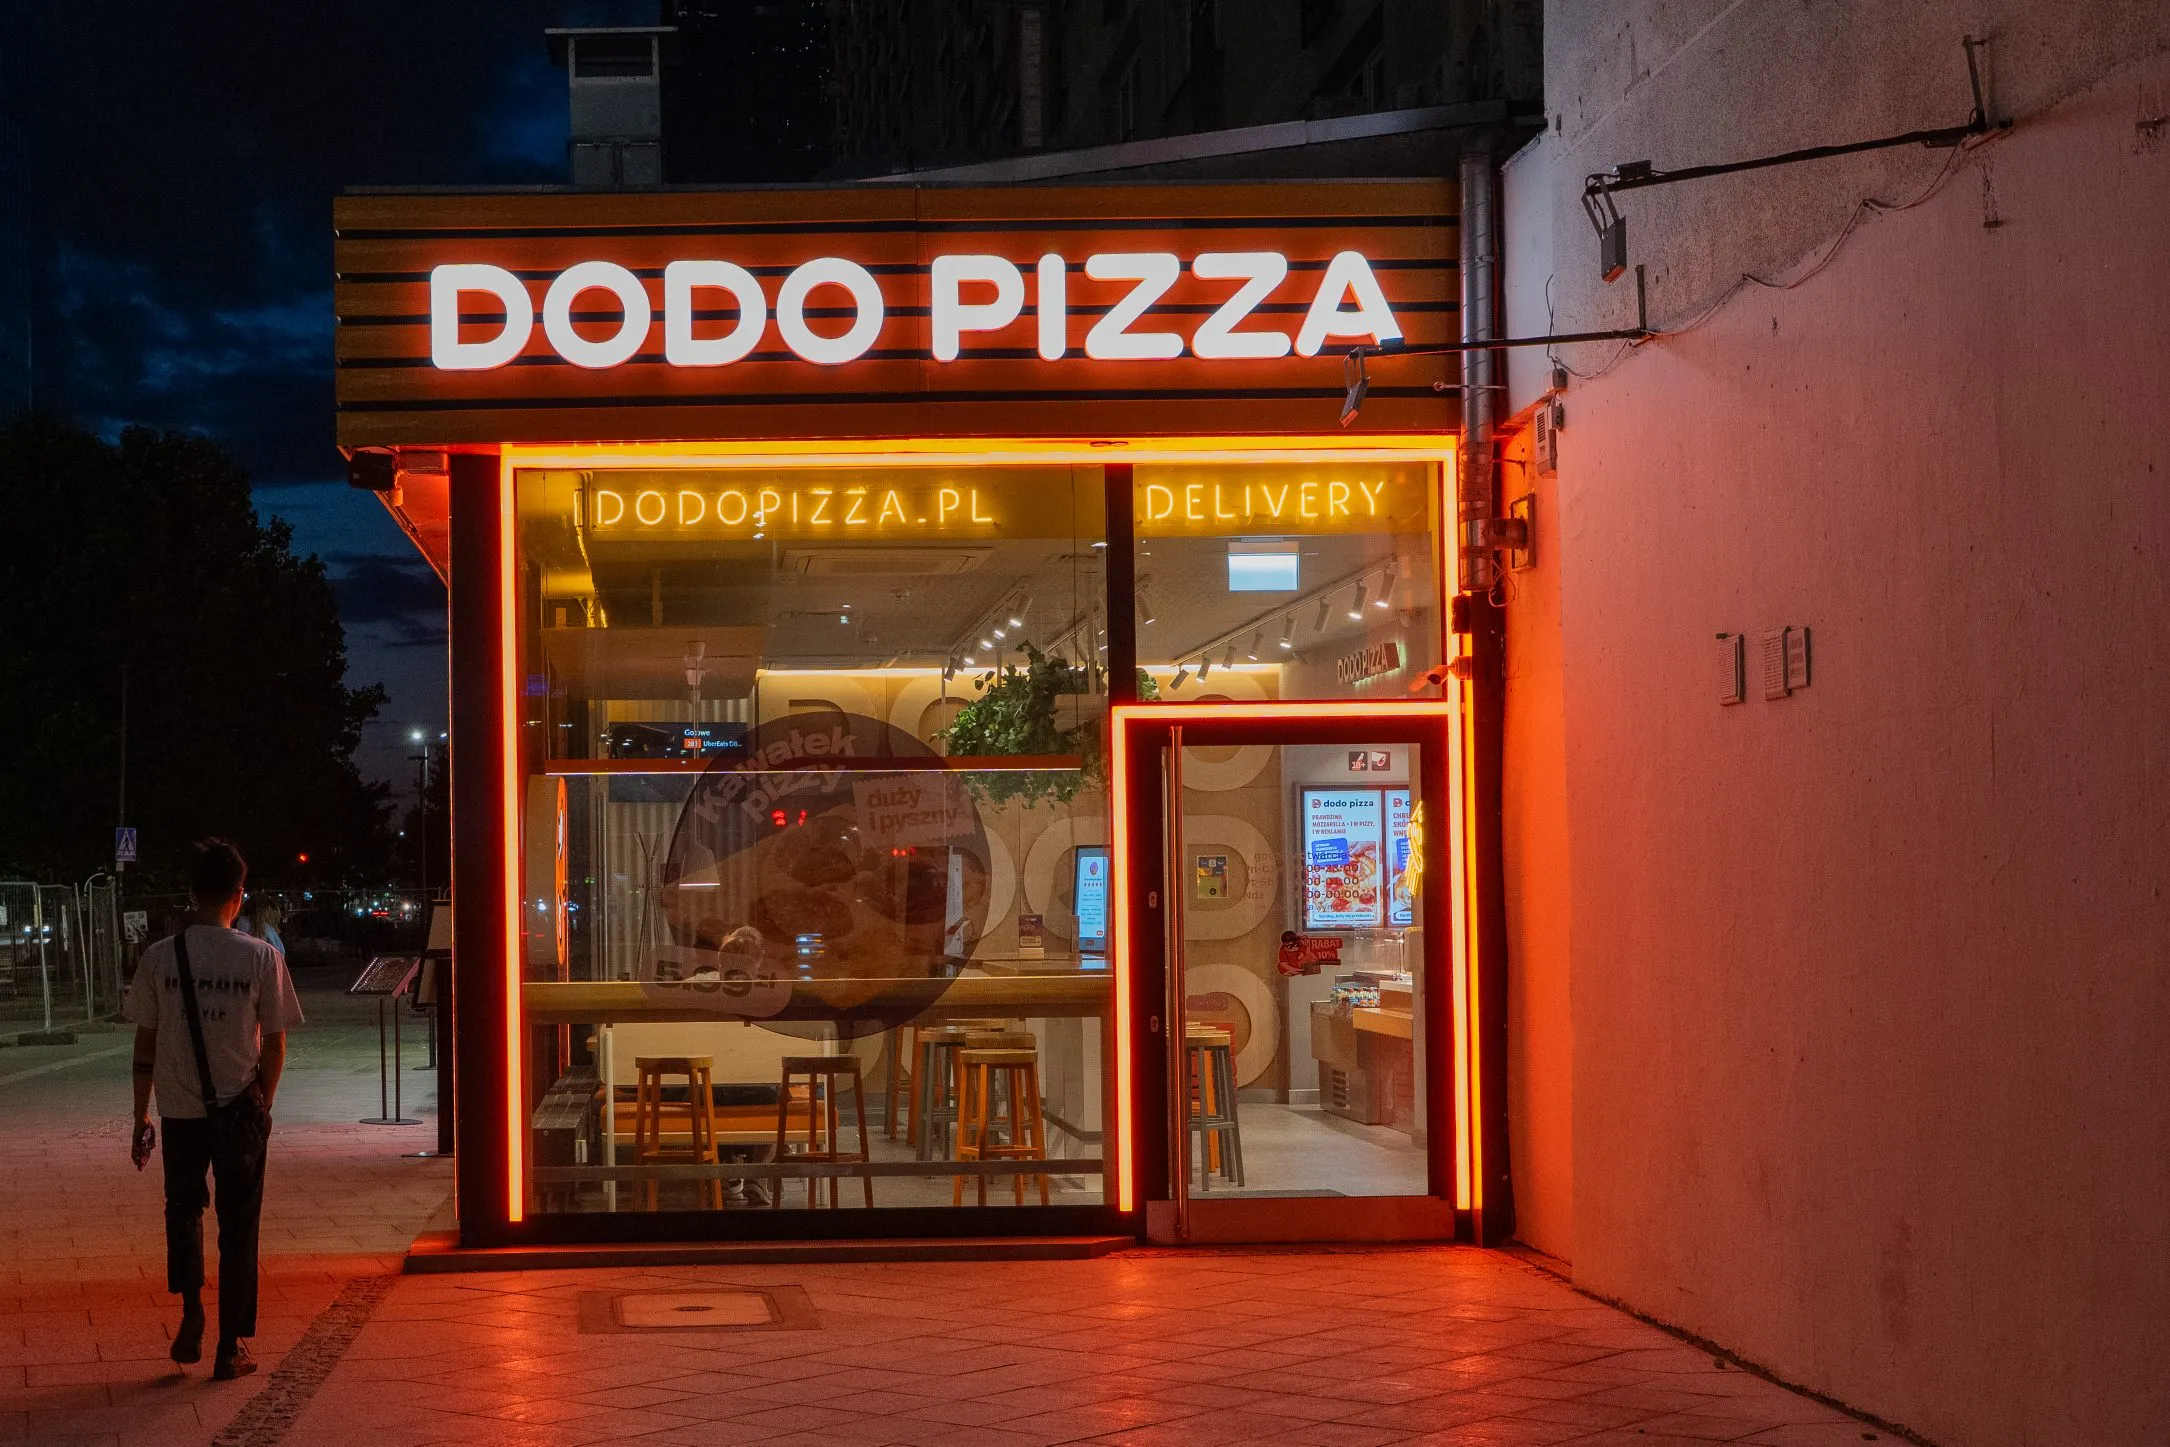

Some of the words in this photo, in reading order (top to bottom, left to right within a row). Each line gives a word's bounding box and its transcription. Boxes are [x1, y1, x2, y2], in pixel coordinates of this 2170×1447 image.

[430, 261, 885, 370] DODO
[931, 251, 1403, 361] PIZZA
[597, 488, 994, 526] DODOPIZZA.PL
[1146, 480, 1385, 520] DELIVERY
[741, 763, 846, 824] pizzy
[867, 787, 922, 809] duży
[1323, 799, 1347, 808] dodo
[1349, 799, 1374, 808] pizza
[1311, 939, 1341, 950] RABAT
